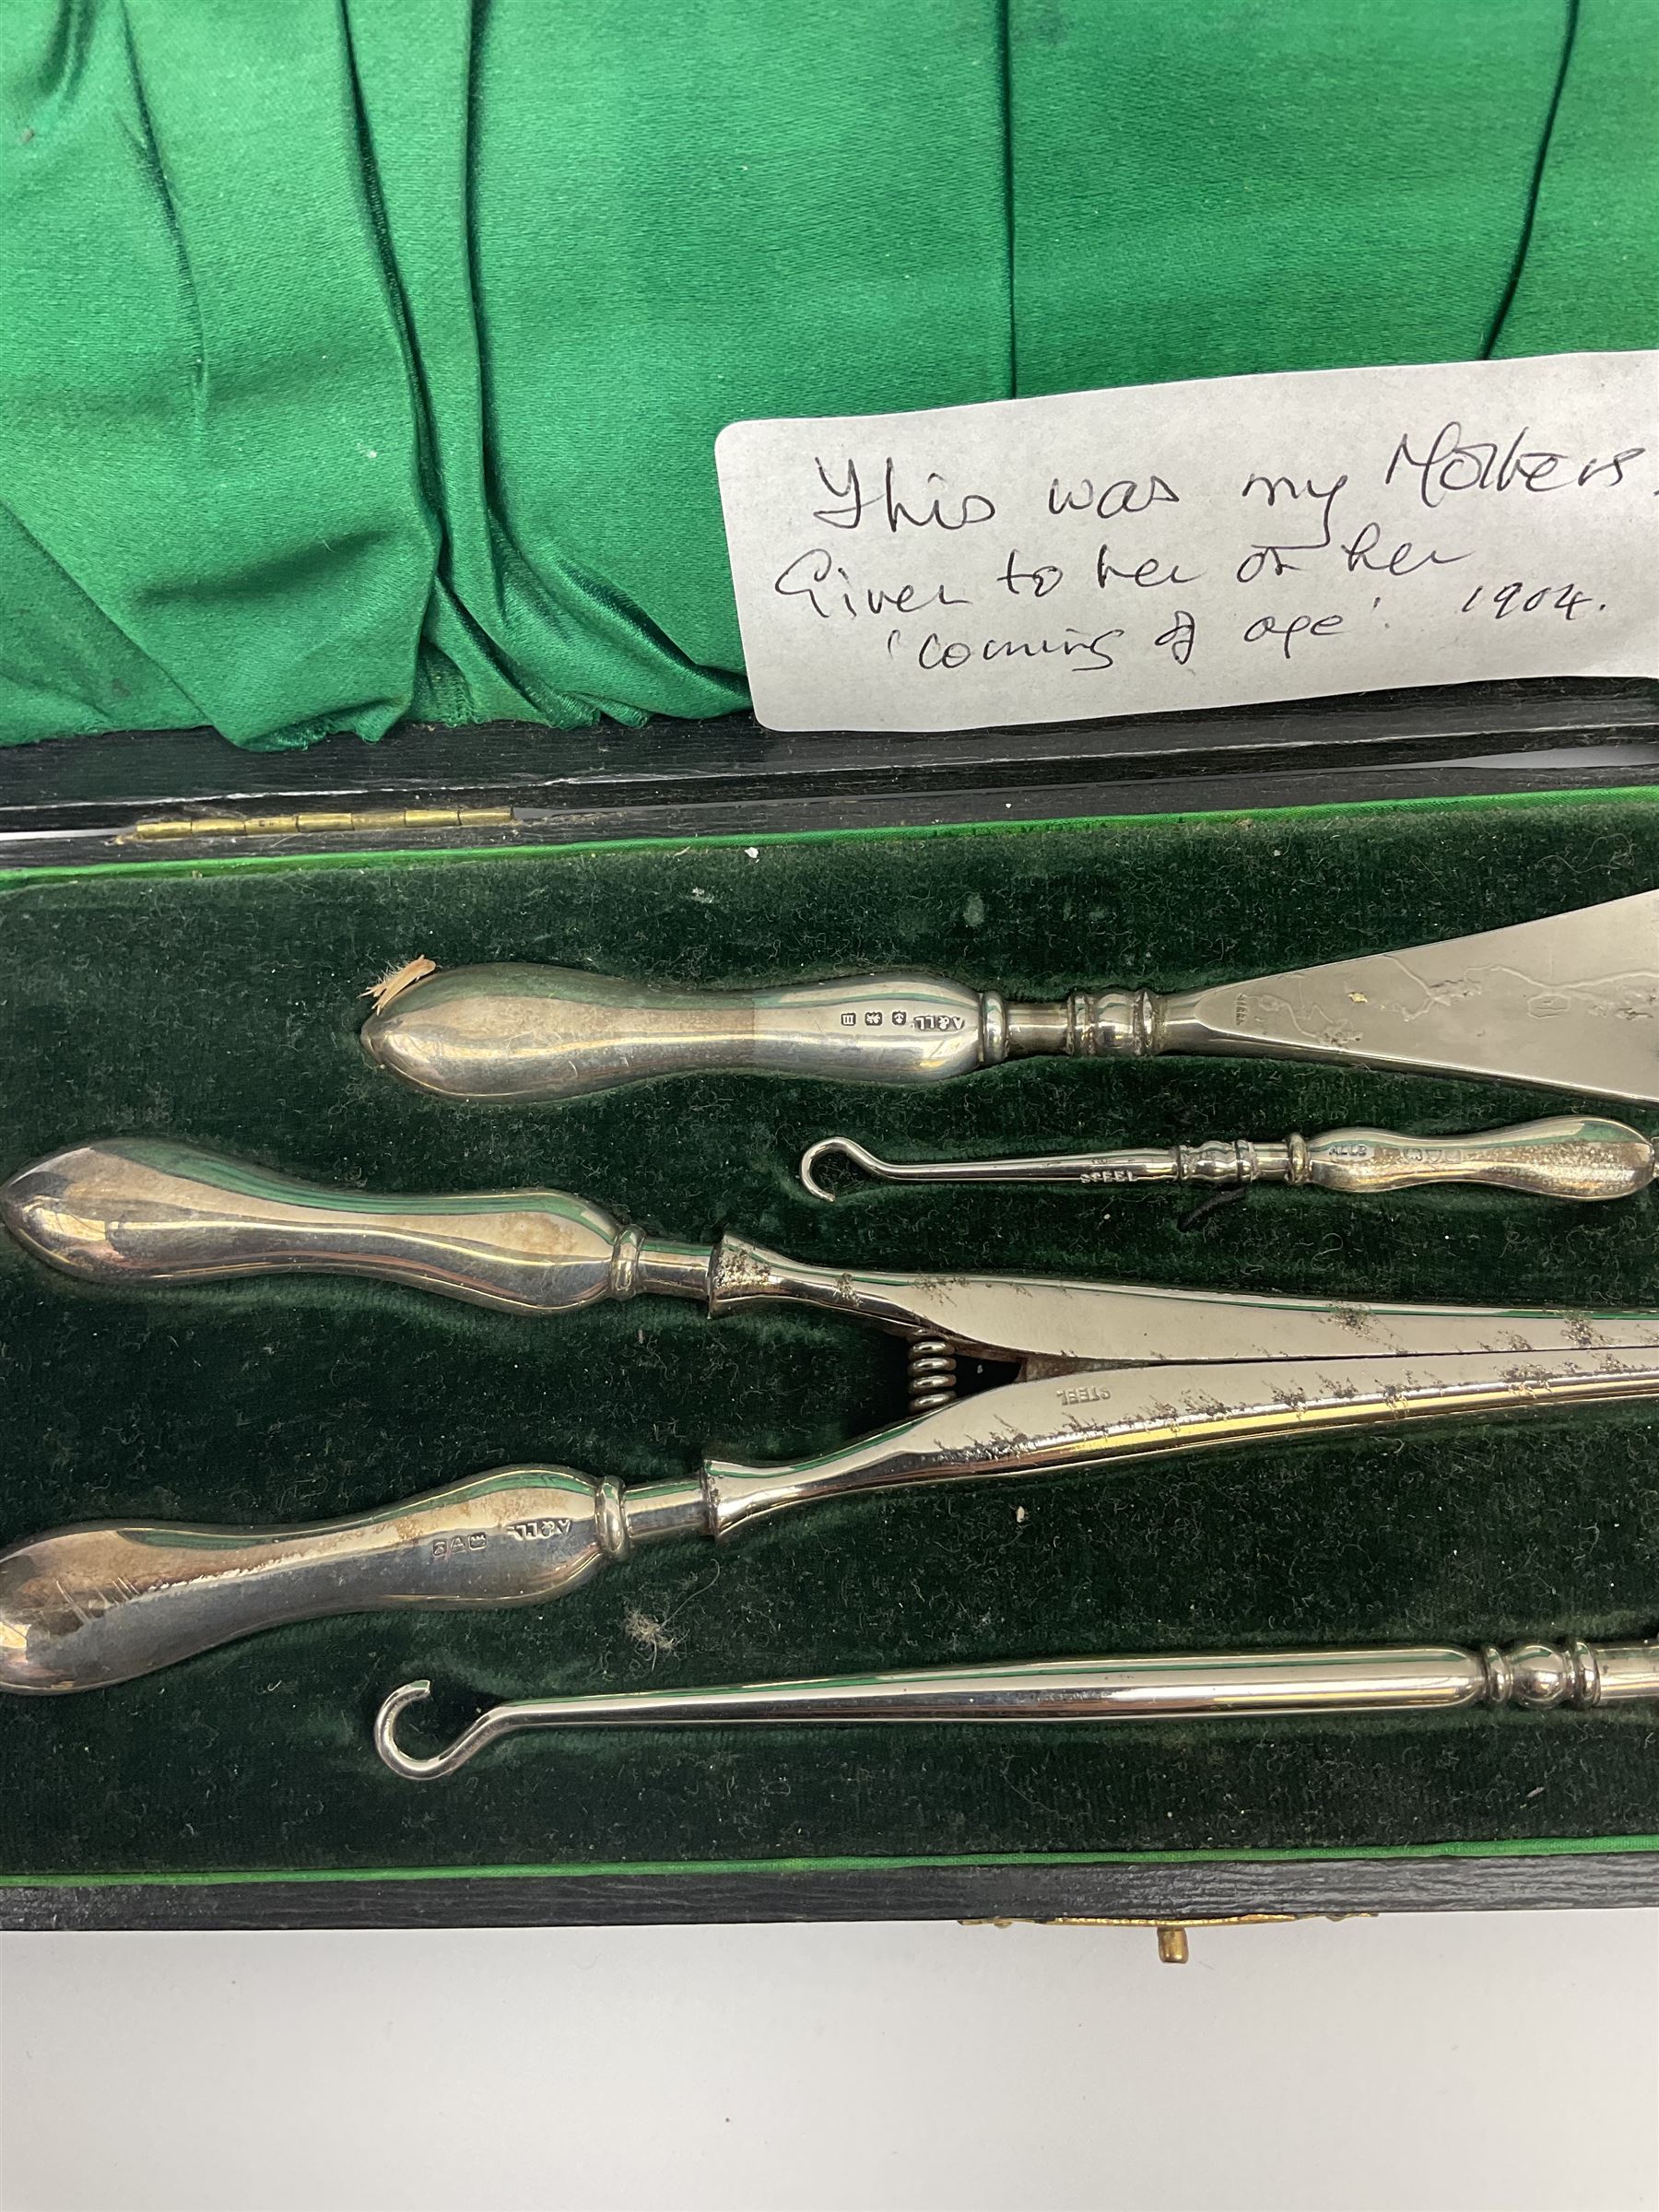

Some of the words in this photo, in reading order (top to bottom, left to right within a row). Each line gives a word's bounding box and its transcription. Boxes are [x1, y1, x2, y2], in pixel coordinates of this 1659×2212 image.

[813, 456, 996, 533] This
[1048, 475, 1180, 519] was
[1241, 473, 1348, 549] my
[773, 547, 973, 618] Given
[997, 548, 1064, 597] to
[1097, 544, 1202, 589] her
[1340, 521, 1477, 576] her
[1079, 1170, 1138, 1183] STEEL
[1055, 1385, 1112, 1406] STEEL
